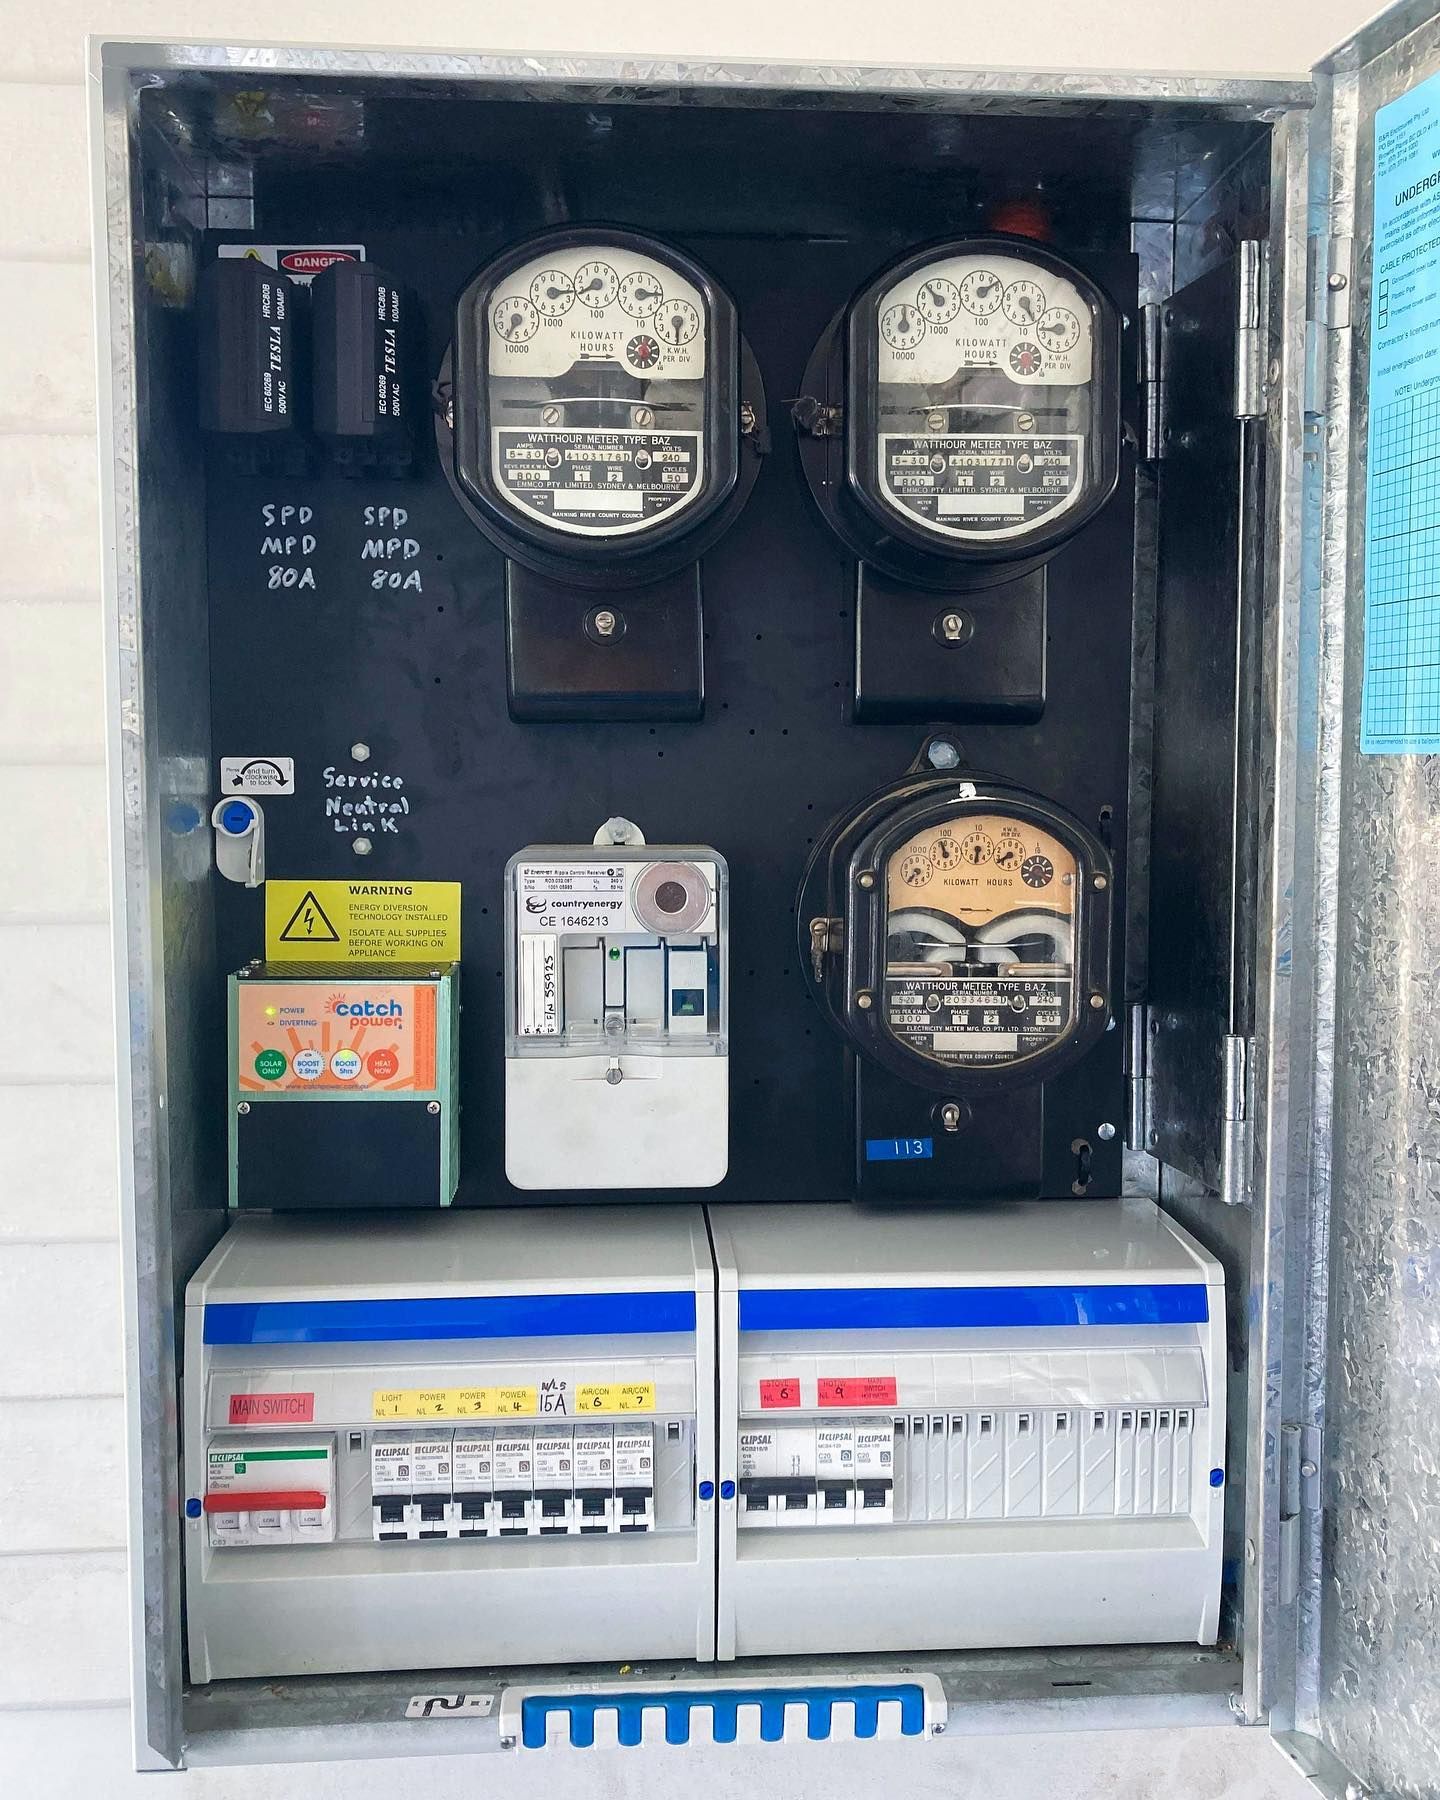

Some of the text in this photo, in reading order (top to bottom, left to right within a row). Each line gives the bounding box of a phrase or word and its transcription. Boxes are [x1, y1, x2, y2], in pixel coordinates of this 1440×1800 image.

[294, 257, 345, 268] DANGE
[1380, 257, 1401, 274] CABLE
[262, 283, 271, 320] HRC80B
[276, 287, 285, 321] 100AMP
[377, 286, 387, 321] HRC80B
[590, 310, 604, 319] 100
[543, 318, 563, 327] 1000
[635, 320, 645, 328] 10
[974, 318, 989, 326] 100
[929, 326, 949, 335] 1000
[1018, 328, 1028, 336] 10
[570, 331, 624, 340] KILOWATT
[580, 343, 614, 352] HOURS
[955, 339, 1007, 347] KILOWATT
[270, 325, 282, 372] TESLA
[385, 328, 397, 374] TESLA
[504, 345, 529, 353] 10000
[891, 352, 915, 360] 10000
[965, 351, 997, 359] HOURS
[278, 380, 286, 393] AC
[392, 383, 400, 395] AC
[263, 372, 272, 412] IEC 60269
[378, 374, 387, 415] IEC 60269
[528, 434, 671, 445] WATTHOUR METER TYPE BAZ
[913, 440, 1052, 449] WATTHOUR METER TYPE BAZ
[662, 454, 680, 462] 240
[262, 504, 313, 526] SPD
[363, 506, 409, 530] SPD
[260, 535, 317, 555] MPD
[361, 537, 421, 560] MPD
[268, 565, 316, 590] 80A
[371, 569, 423, 592] 80A
[322, 766, 404, 789] Service
[326, 795, 410, 816] Neutral
[939, 829, 952, 837] 100
[909, 846, 927, 854] 1000
[349, 885, 413, 895] WARNING
[349, 904, 428, 912] ENERGY DIVERSION
[551, 900, 623, 911] countryenergy
[349, 913, 448, 921] TECHNOLOGY INSTALLED
[539, 917, 609, 927] CE 1646213
[349, 929, 447, 937] ISOLATE ALL SUPPLIES
[349, 939, 444, 947] BEFORE WORKING ON
[348, 949, 397, 957] APPLIANCE
[906, 982, 958, 990] WATTHOUR
[962, 982, 993, 990] METER
[997, 982, 1020, 991] TYPE
[1037, 996, 1054, 1004] 240
[336, 999, 403, 1016] catch
[350, 1017, 402, 1030] power
[895, 1140, 923, 1155] 113
[500, 1391, 526, 1399] POWER
[581, 1388, 609, 1396] AIR/CON
[621, 1387, 649, 1395] AIR/CON
[381, 1394, 403, 1402] LIGHT
[419, 1393, 446, 1401] POWER
[459, 1392, 486, 1400] POWER
[636, 1396, 643, 1404] 7
[474, 1401, 482, 1410] 3
[540, 1393, 567, 1415] 15A
[593, 1396, 602, 1407] 6
[232, 1398, 306, 1415] MAIN SWITCH
[435, 1403, 444, 1412] 2
[741, 1435, 772, 1445] CLIPSAL
[824, 1433, 853, 1441] CLIPSAL
[863, 1434, 891, 1443] CLIPSAL
[462, 1444, 491, 1452] CLIPSAL
[502, 1443, 530, 1452] CLIPSAL
[542, 1442, 571, 1450] CLIPSAL
[582, 1442, 611, 1450] CLIPSAL
[623, 1440, 651, 1448] CLIPSAL
[381, 1448, 410, 1457] CLIPSAL
[421, 1445, 449, 1453] CLIPSAL
